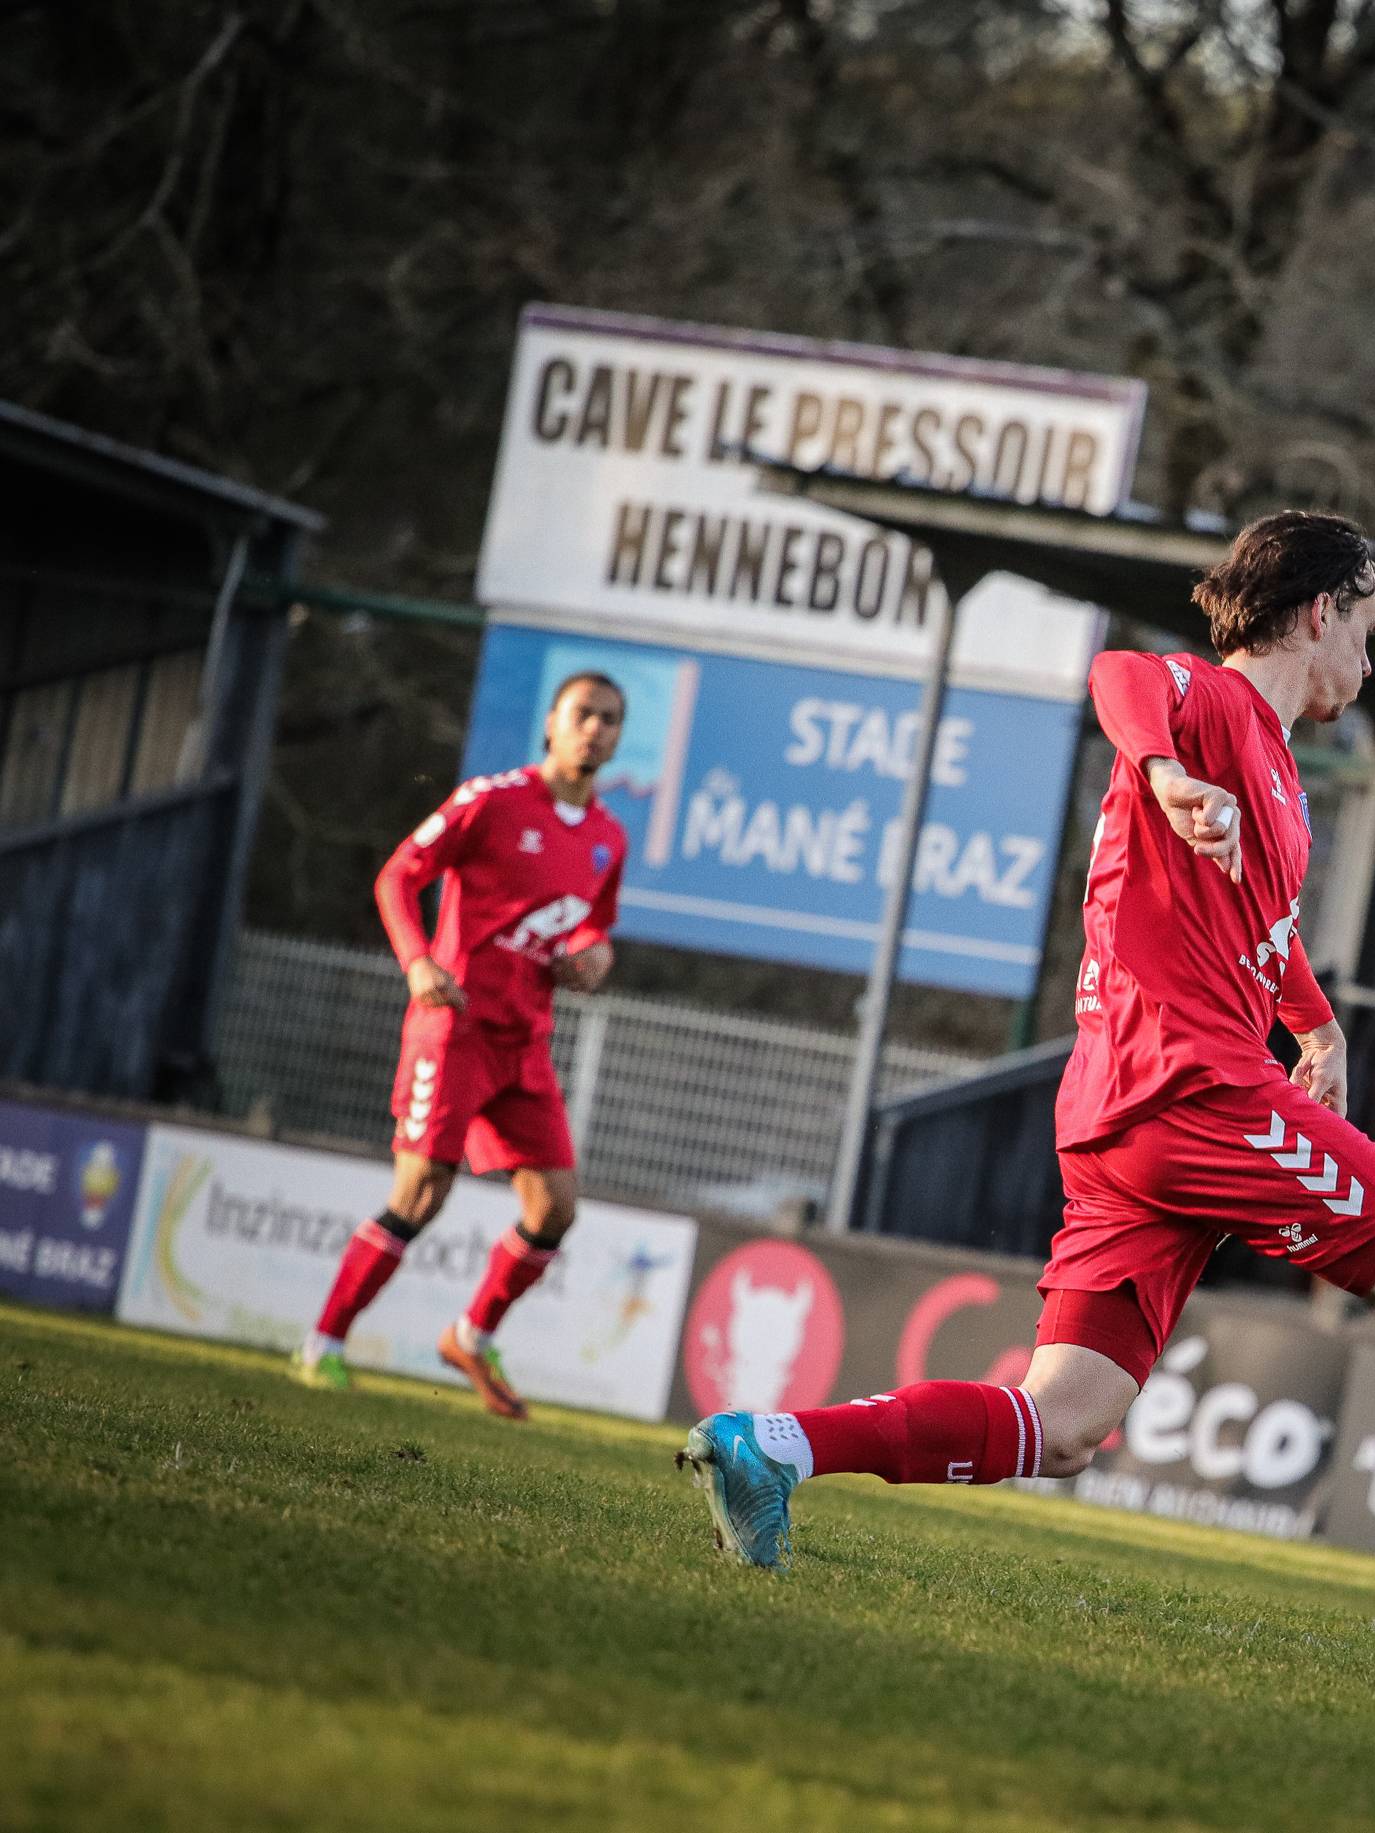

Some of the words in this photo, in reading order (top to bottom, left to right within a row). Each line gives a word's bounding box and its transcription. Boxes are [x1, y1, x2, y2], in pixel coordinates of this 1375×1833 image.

[531, 357, 694, 459] CAVE
[707, 381, 771, 463] LE
[788, 390, 1103, 506] PRESSOIR
[683, 786, 870, 887] MANÉ
[1286, 1233, 1319, 1253] hummel
